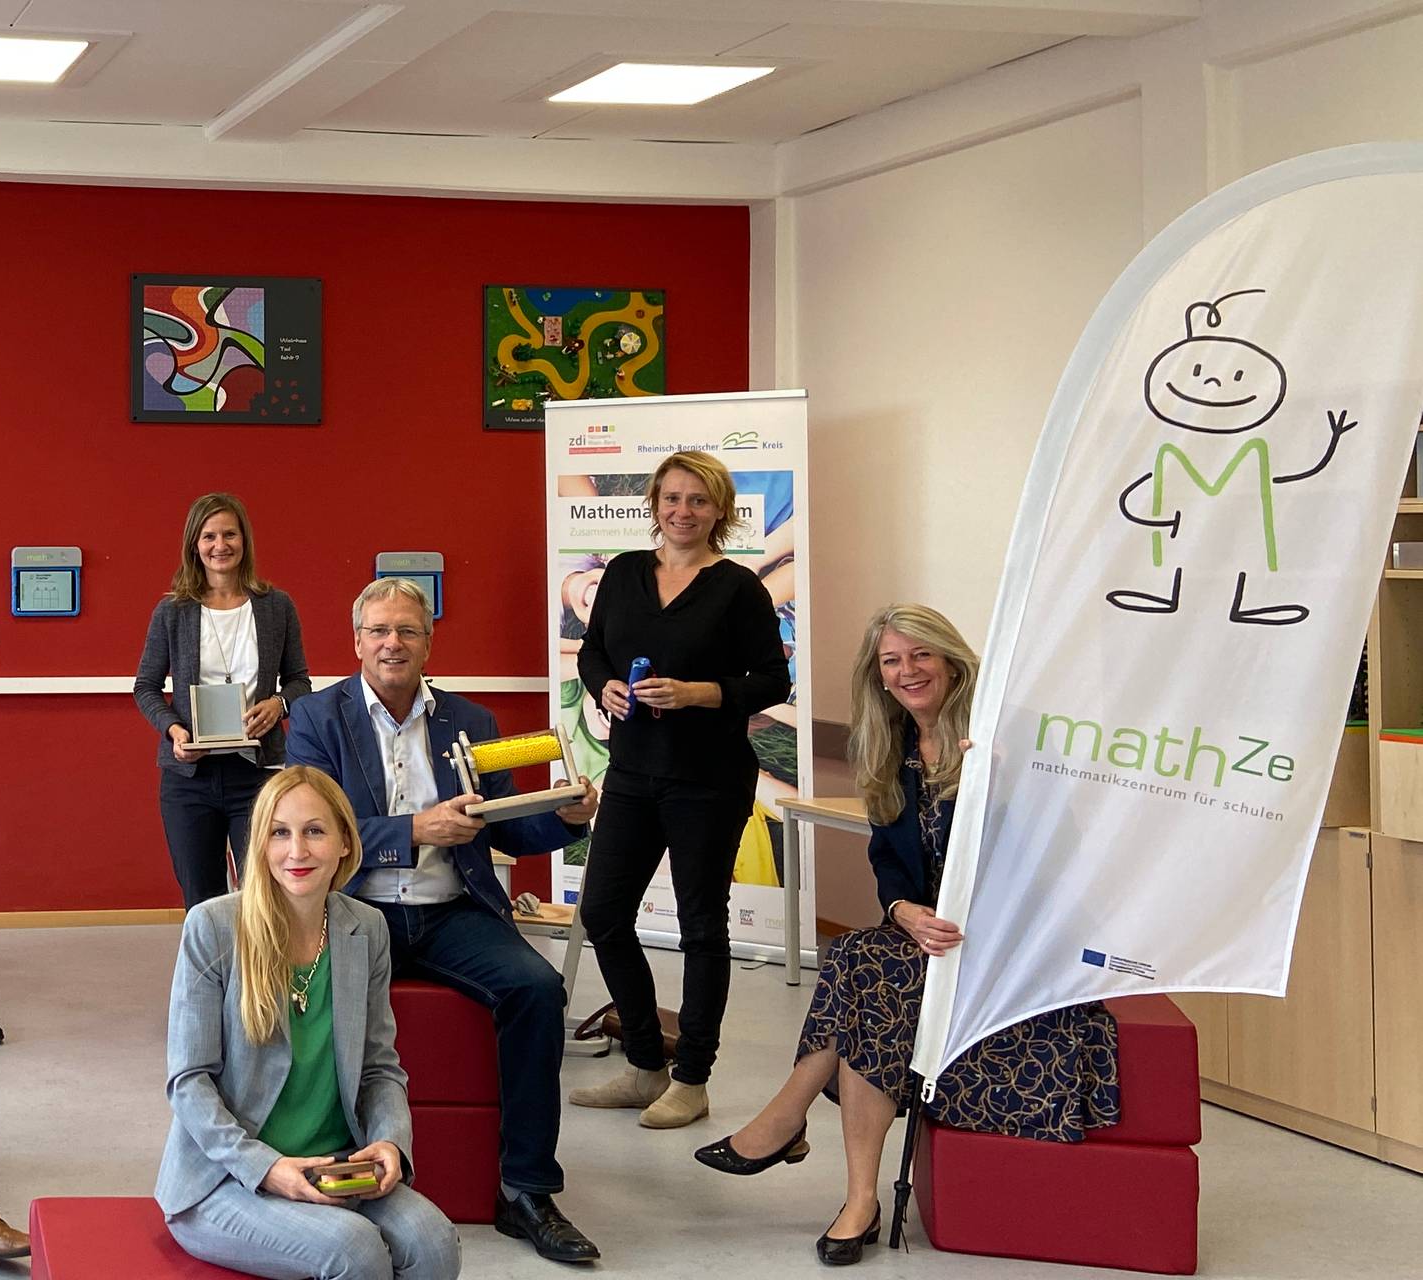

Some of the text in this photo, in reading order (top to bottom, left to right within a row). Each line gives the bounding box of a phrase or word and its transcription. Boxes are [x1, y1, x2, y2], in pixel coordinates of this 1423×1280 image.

[568, 434, 586, 446] zdi
[762, 441, 783, 450] Kreis
[569, 527, 621, 537] Zusammen
[1031, 760, 1284, 822] mathematikzentrum für schulen
